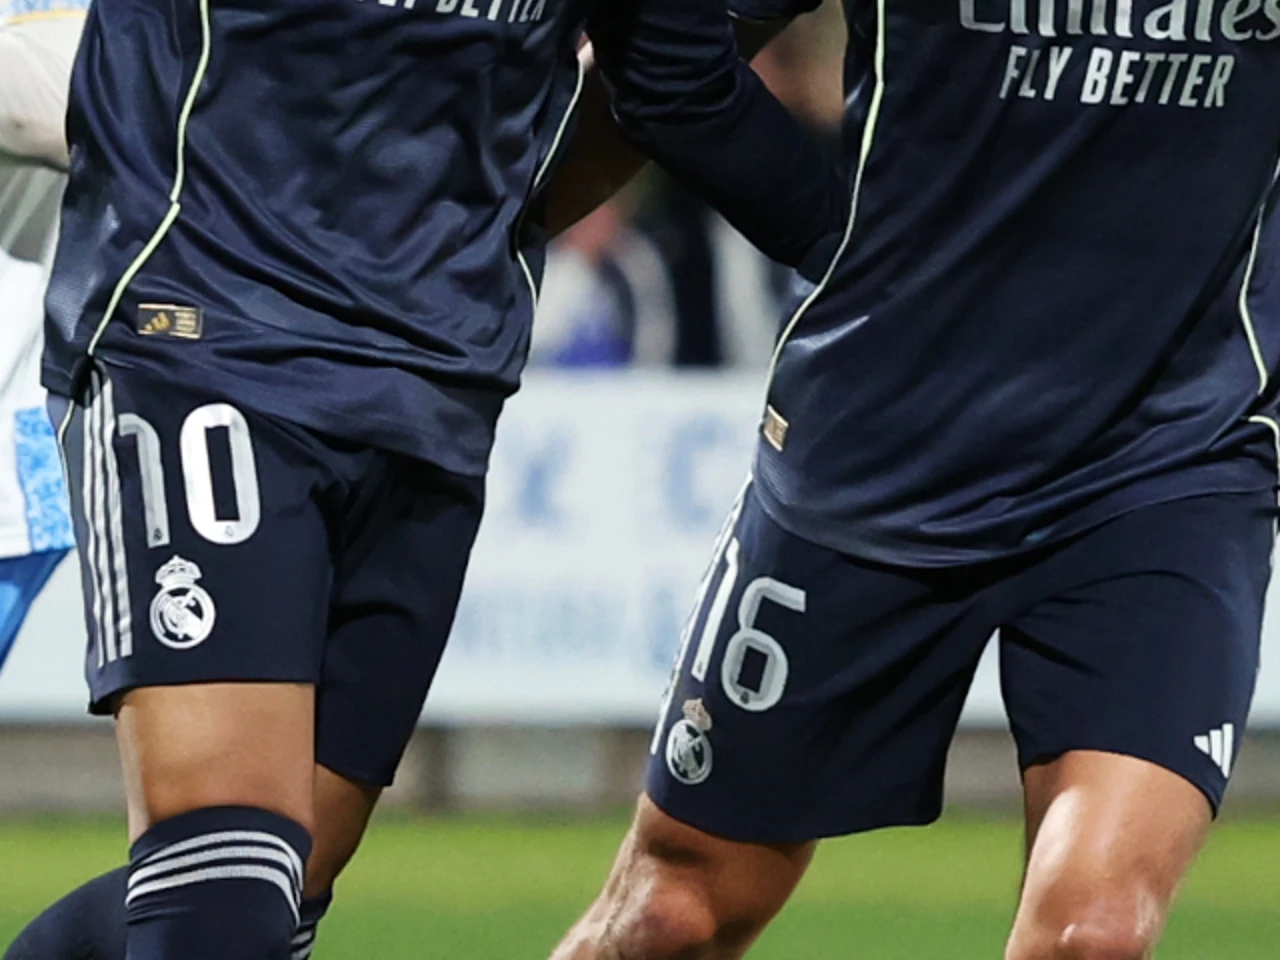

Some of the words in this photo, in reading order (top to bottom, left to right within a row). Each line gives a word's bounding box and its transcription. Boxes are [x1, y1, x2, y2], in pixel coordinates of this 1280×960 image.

[998, 44, 1072, 101] FLY
[1079, 47, 1235, 108] BETTER
[117, 402, 261, 549] 10
[691, 537, 807, 712] 16
